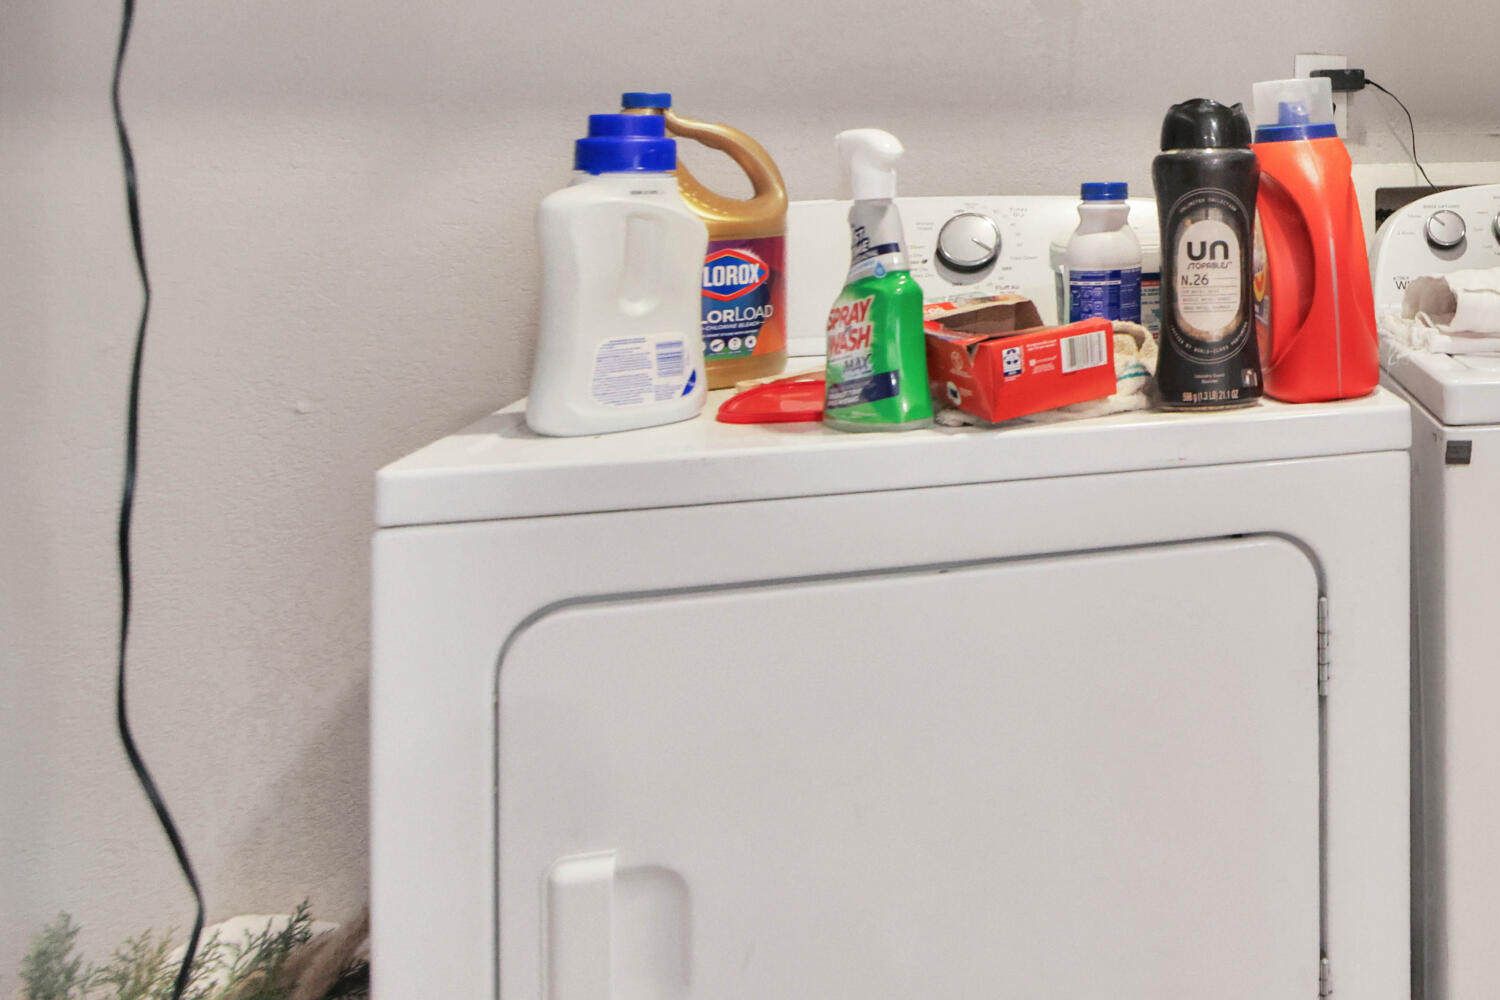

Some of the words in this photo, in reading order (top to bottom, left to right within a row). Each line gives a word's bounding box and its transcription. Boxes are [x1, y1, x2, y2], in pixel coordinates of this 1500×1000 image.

[702, 263, 760, 288] LOROX
[1181, 274, 1210, 286] N.26
[827, 297, 874, 332] SPRAY
[828, 324, 872, 357] WASH
